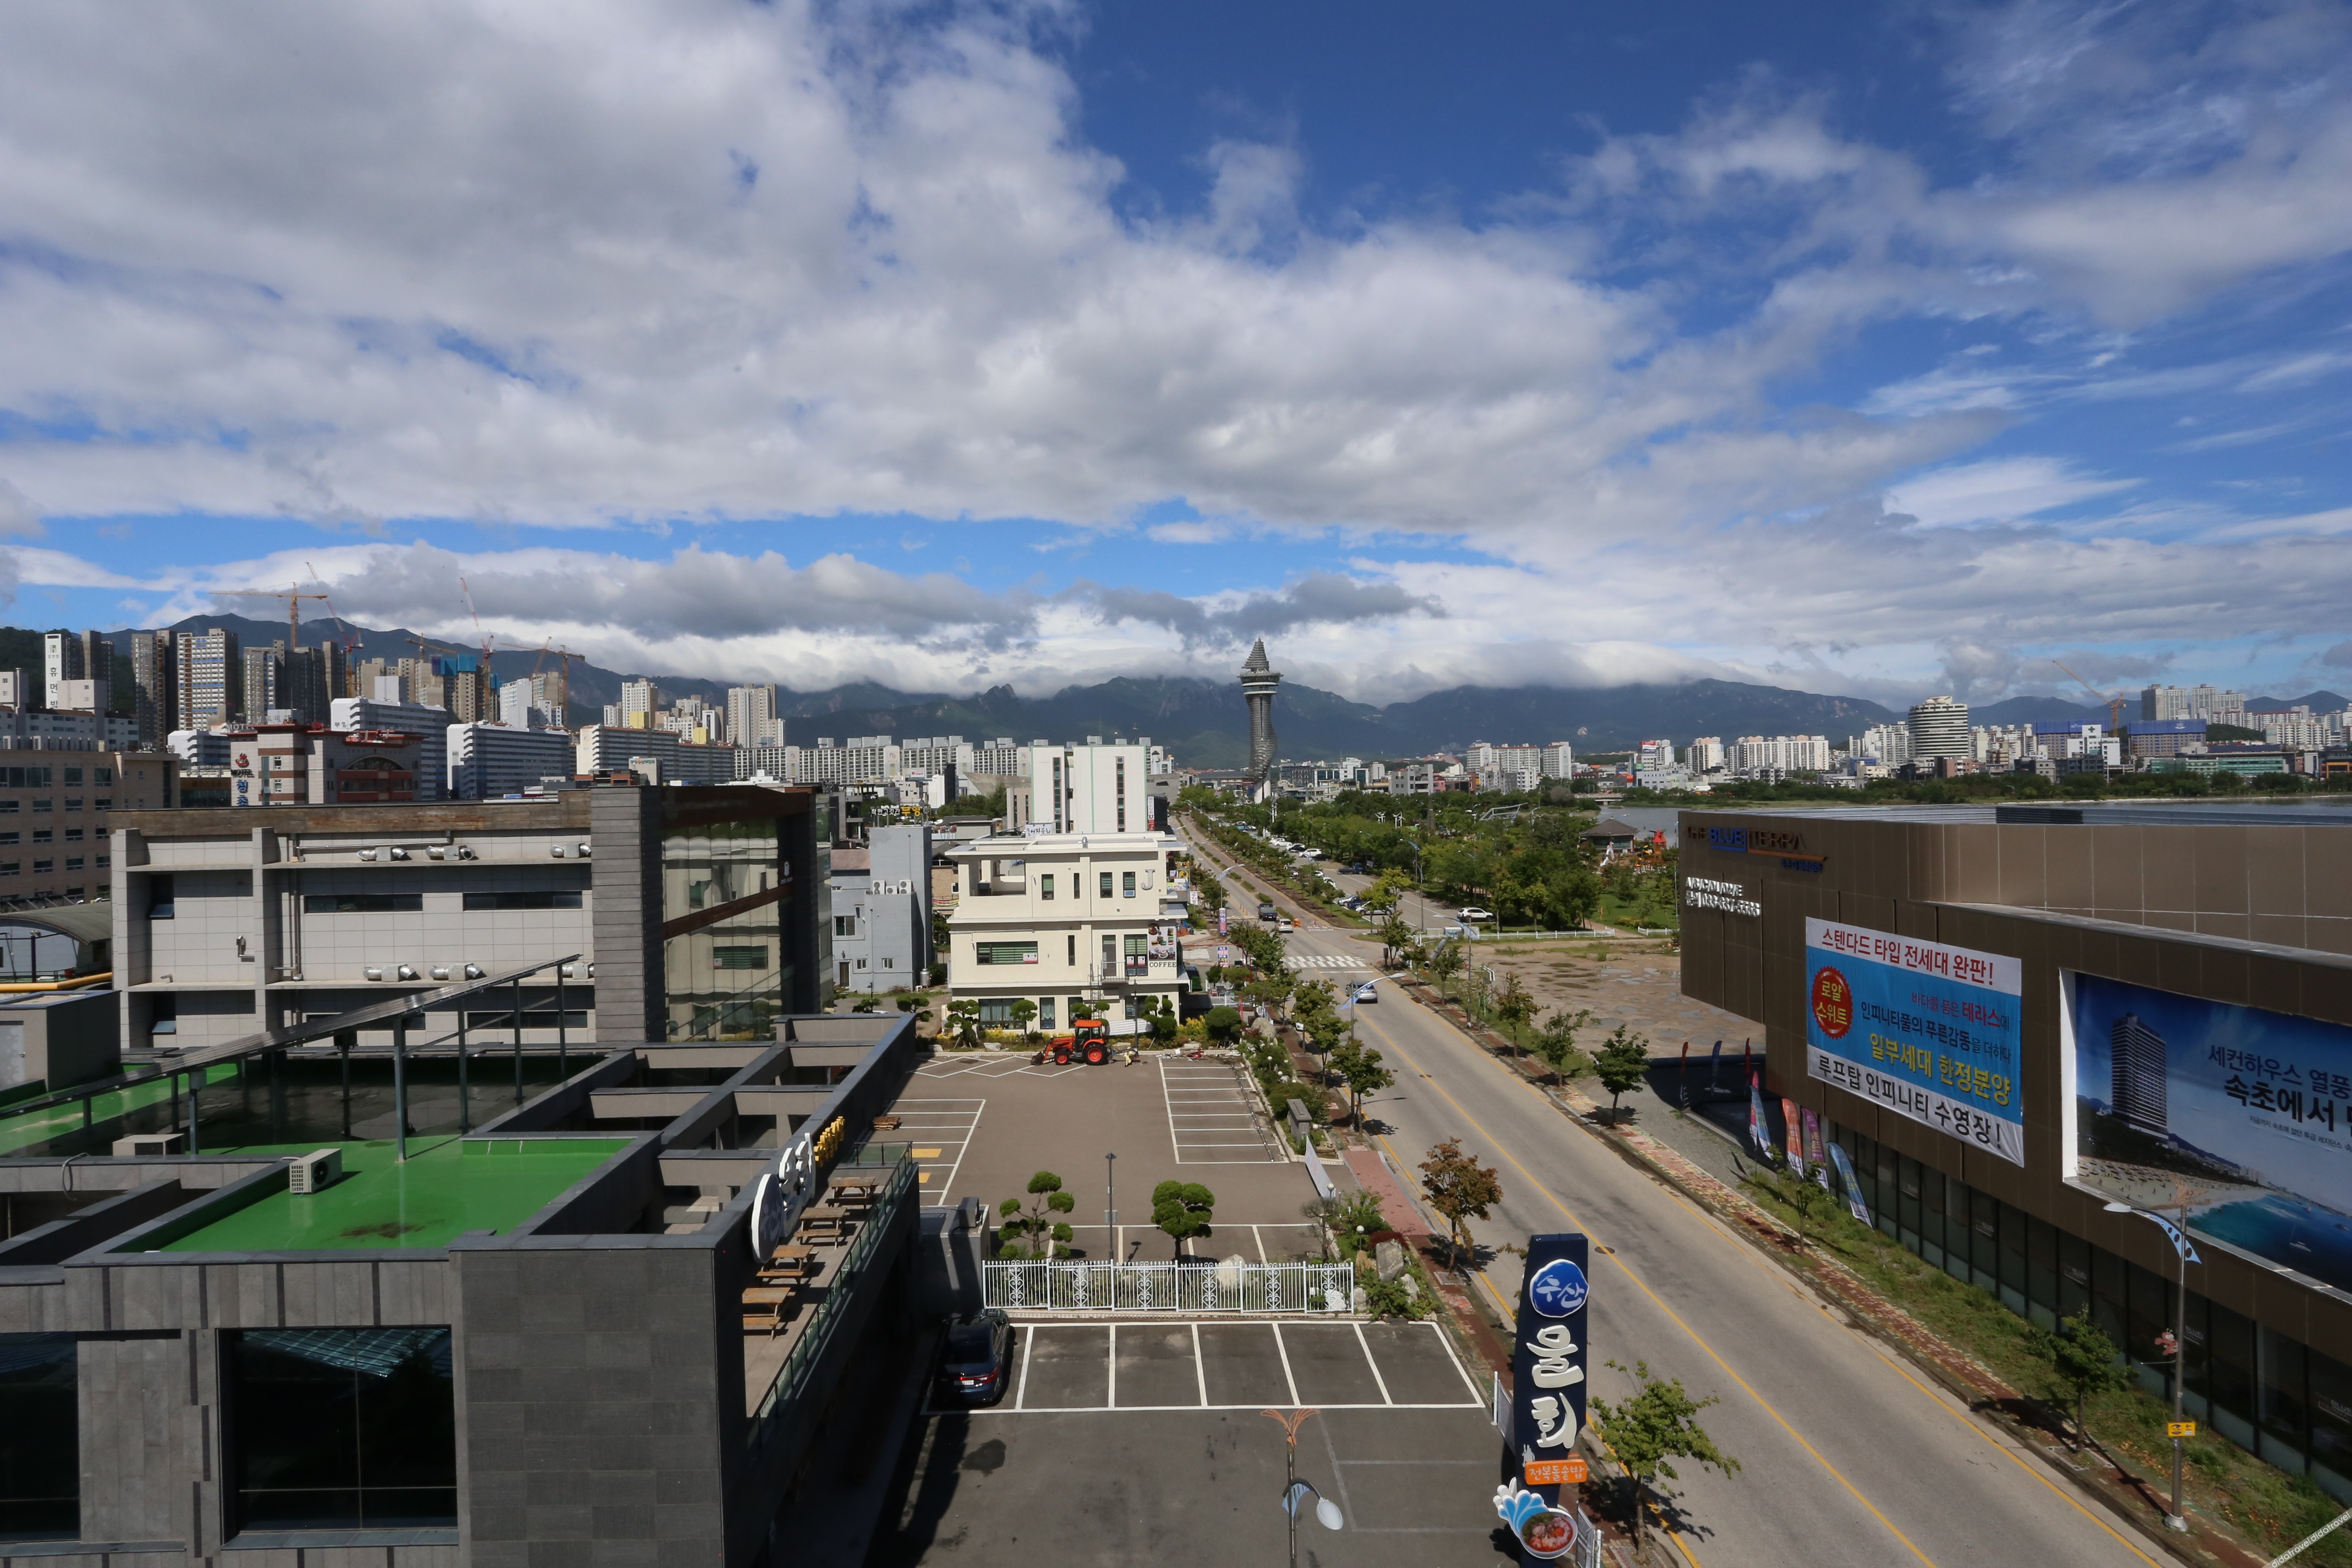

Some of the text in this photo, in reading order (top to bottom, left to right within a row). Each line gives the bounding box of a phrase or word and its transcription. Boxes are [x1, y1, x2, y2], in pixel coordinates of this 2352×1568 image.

[1822, 928, 1994, 986] 스텐다드 타입 전세대 완판!
[1816, 1004, 1848, 1026] 스위트
[1821, 981, 1842, 1002] 로얄
[1911, 992, 2009, 1032] 바다를 품은 테라스에
[1861, 1001, 2011, 1063] 인피니티풀의 푸른감동을 더하다
[1869, 1032, 2011, 1106] 일부세대 한정분양
[2208, 1045, 2352, 1100] 세컨하우스 열풍
[1819, 1055, 2001, 1149] 루프탑 인피니티 수영장!
[2224, 1075, 2334, 1133] 속초에서
[2249, 1115, 2271, 1127] 지금까지
[2272, 1122, 2289, 1133] 속초에
[2291, 1128, 2302, 1137] 없던
[2318, 1136, 2342, 1149] 레지던스
[1536, 1275, 1585, 1308] 수산
[1529, 1465, 1585, 1482] 전복돌솥밥
